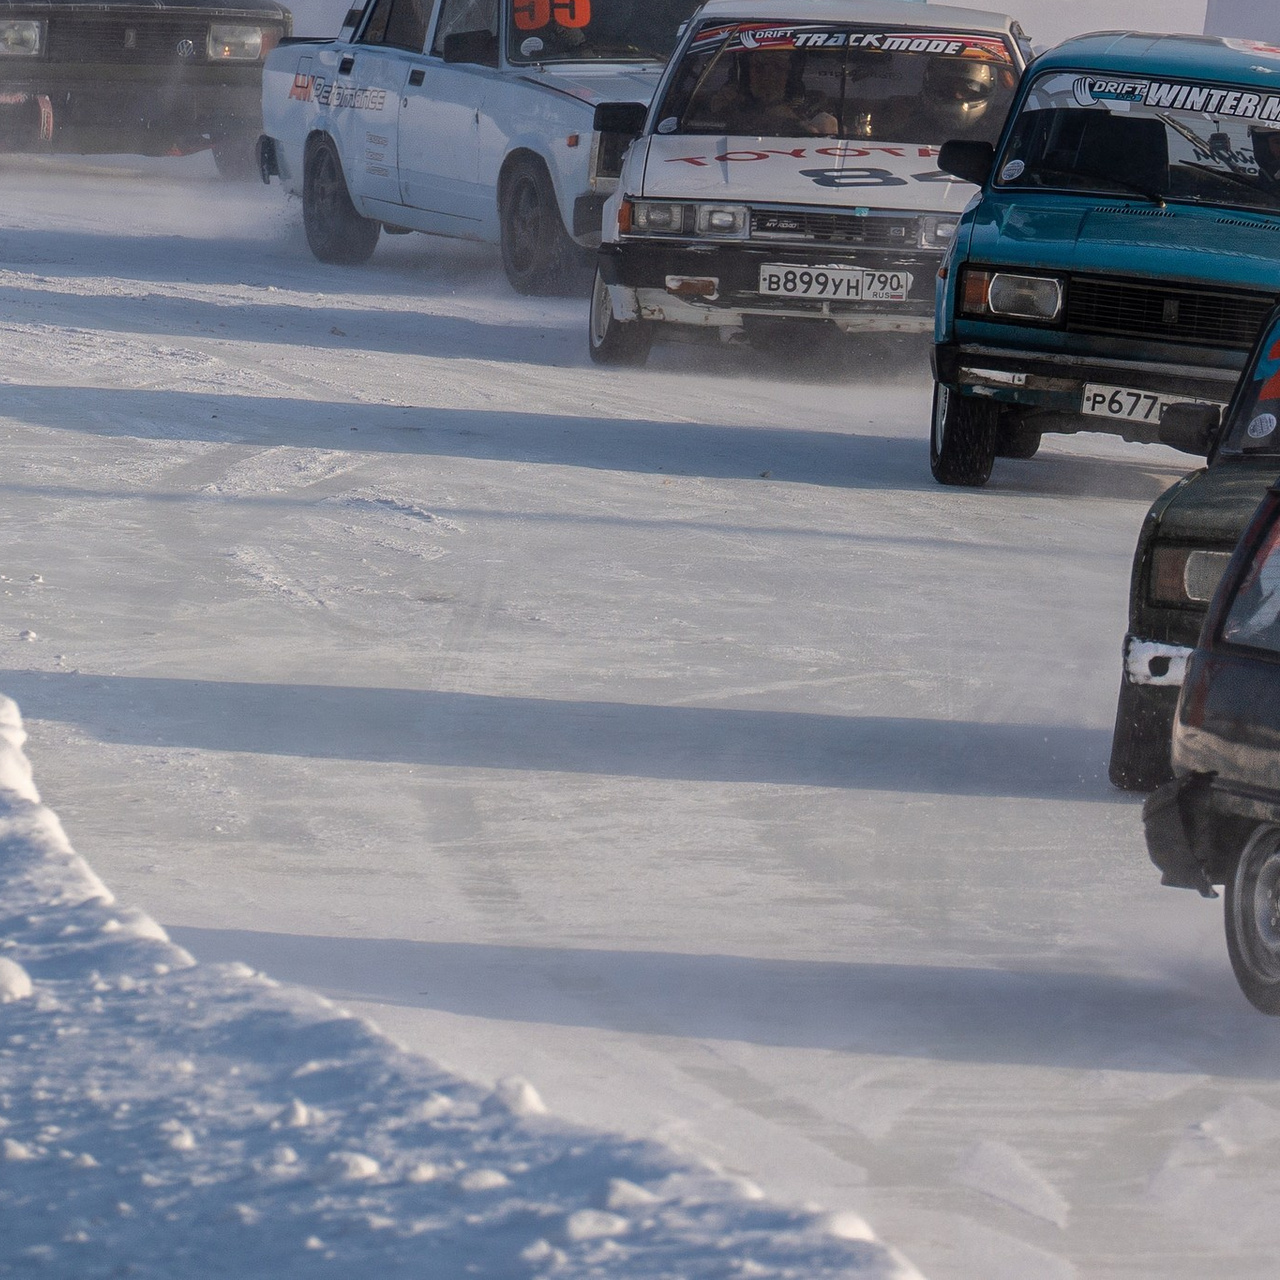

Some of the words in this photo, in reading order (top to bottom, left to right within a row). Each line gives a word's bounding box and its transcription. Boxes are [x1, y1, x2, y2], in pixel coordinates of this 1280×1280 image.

[755, 30, 794, 40] DRIFT
[795, 32, 884, 48] TRACK
[881, 37, 964, 55] MODE
[1093, 80, 1146, 95] DRIFT
[1145, 82, 1259, 118] WINTER
[865, 272, 901, 291] 790
[872, 291, 890, 299] RUS
